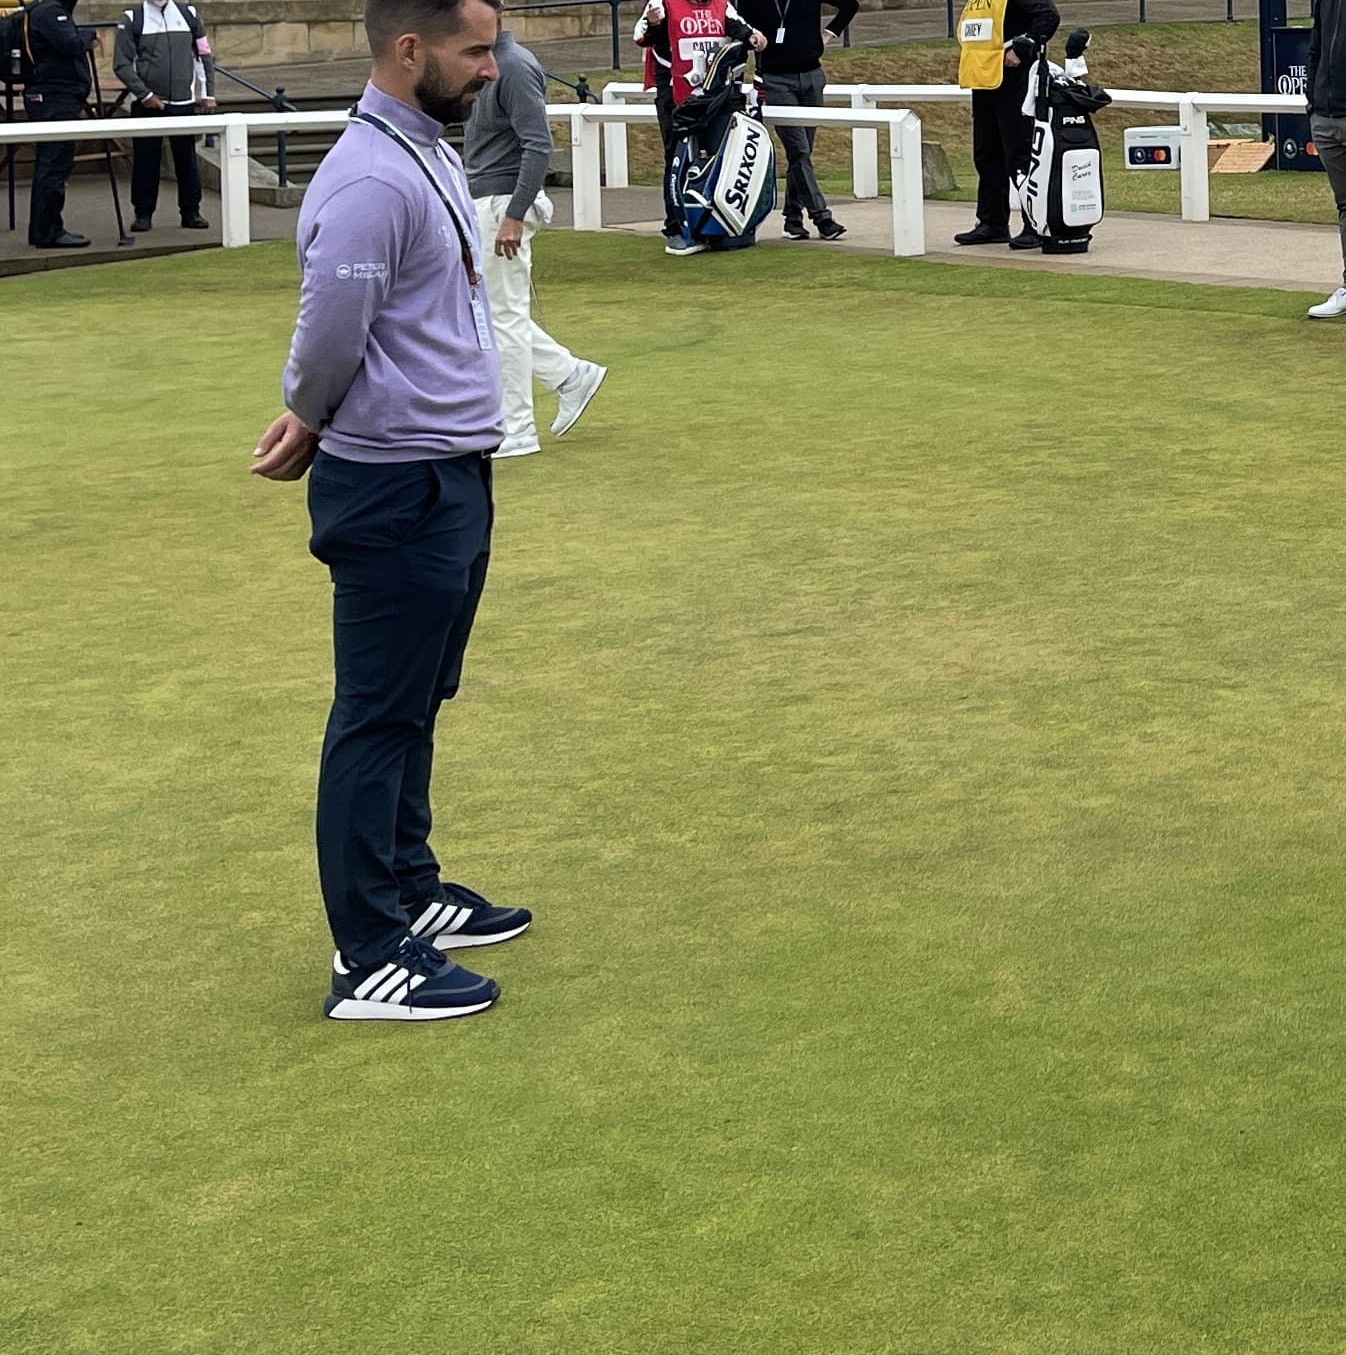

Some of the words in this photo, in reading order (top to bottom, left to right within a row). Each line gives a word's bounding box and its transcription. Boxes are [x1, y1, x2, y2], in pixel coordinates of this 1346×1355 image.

[680, 16, 725, 35] OPEN
[1288, 65, 1308, 77] THE
[1278, 75, 1308, 95] OPE
[1063, 116, 1085, 125] PING
[725, 127, 762, 216] SRIXON
[1027, 127, 1045, 228] PING
[353, 262, 385, 270] PETER
